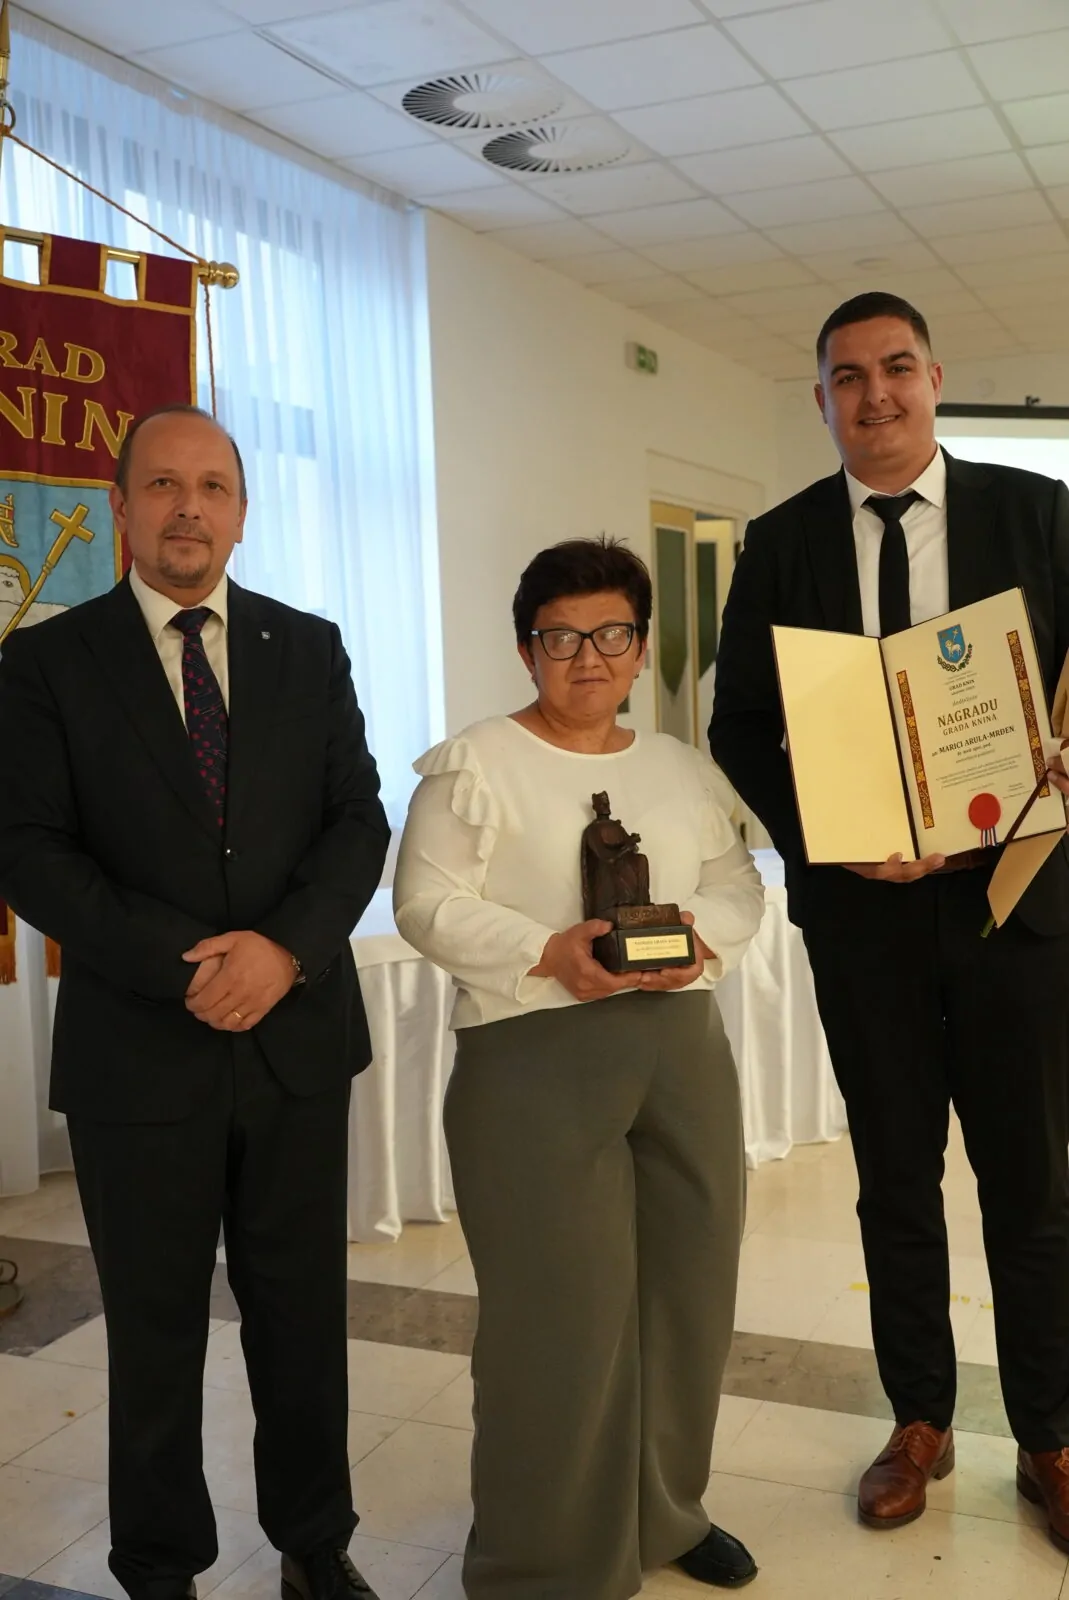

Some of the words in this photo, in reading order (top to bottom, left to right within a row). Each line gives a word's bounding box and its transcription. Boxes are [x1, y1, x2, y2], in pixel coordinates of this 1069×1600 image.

[937, 698, 998, 728] NAGRADU
[943, 722, 970, 736] GRADA
[971, 713, 997, 728] KNINA
[939, 741, 963, 754] MARICI
